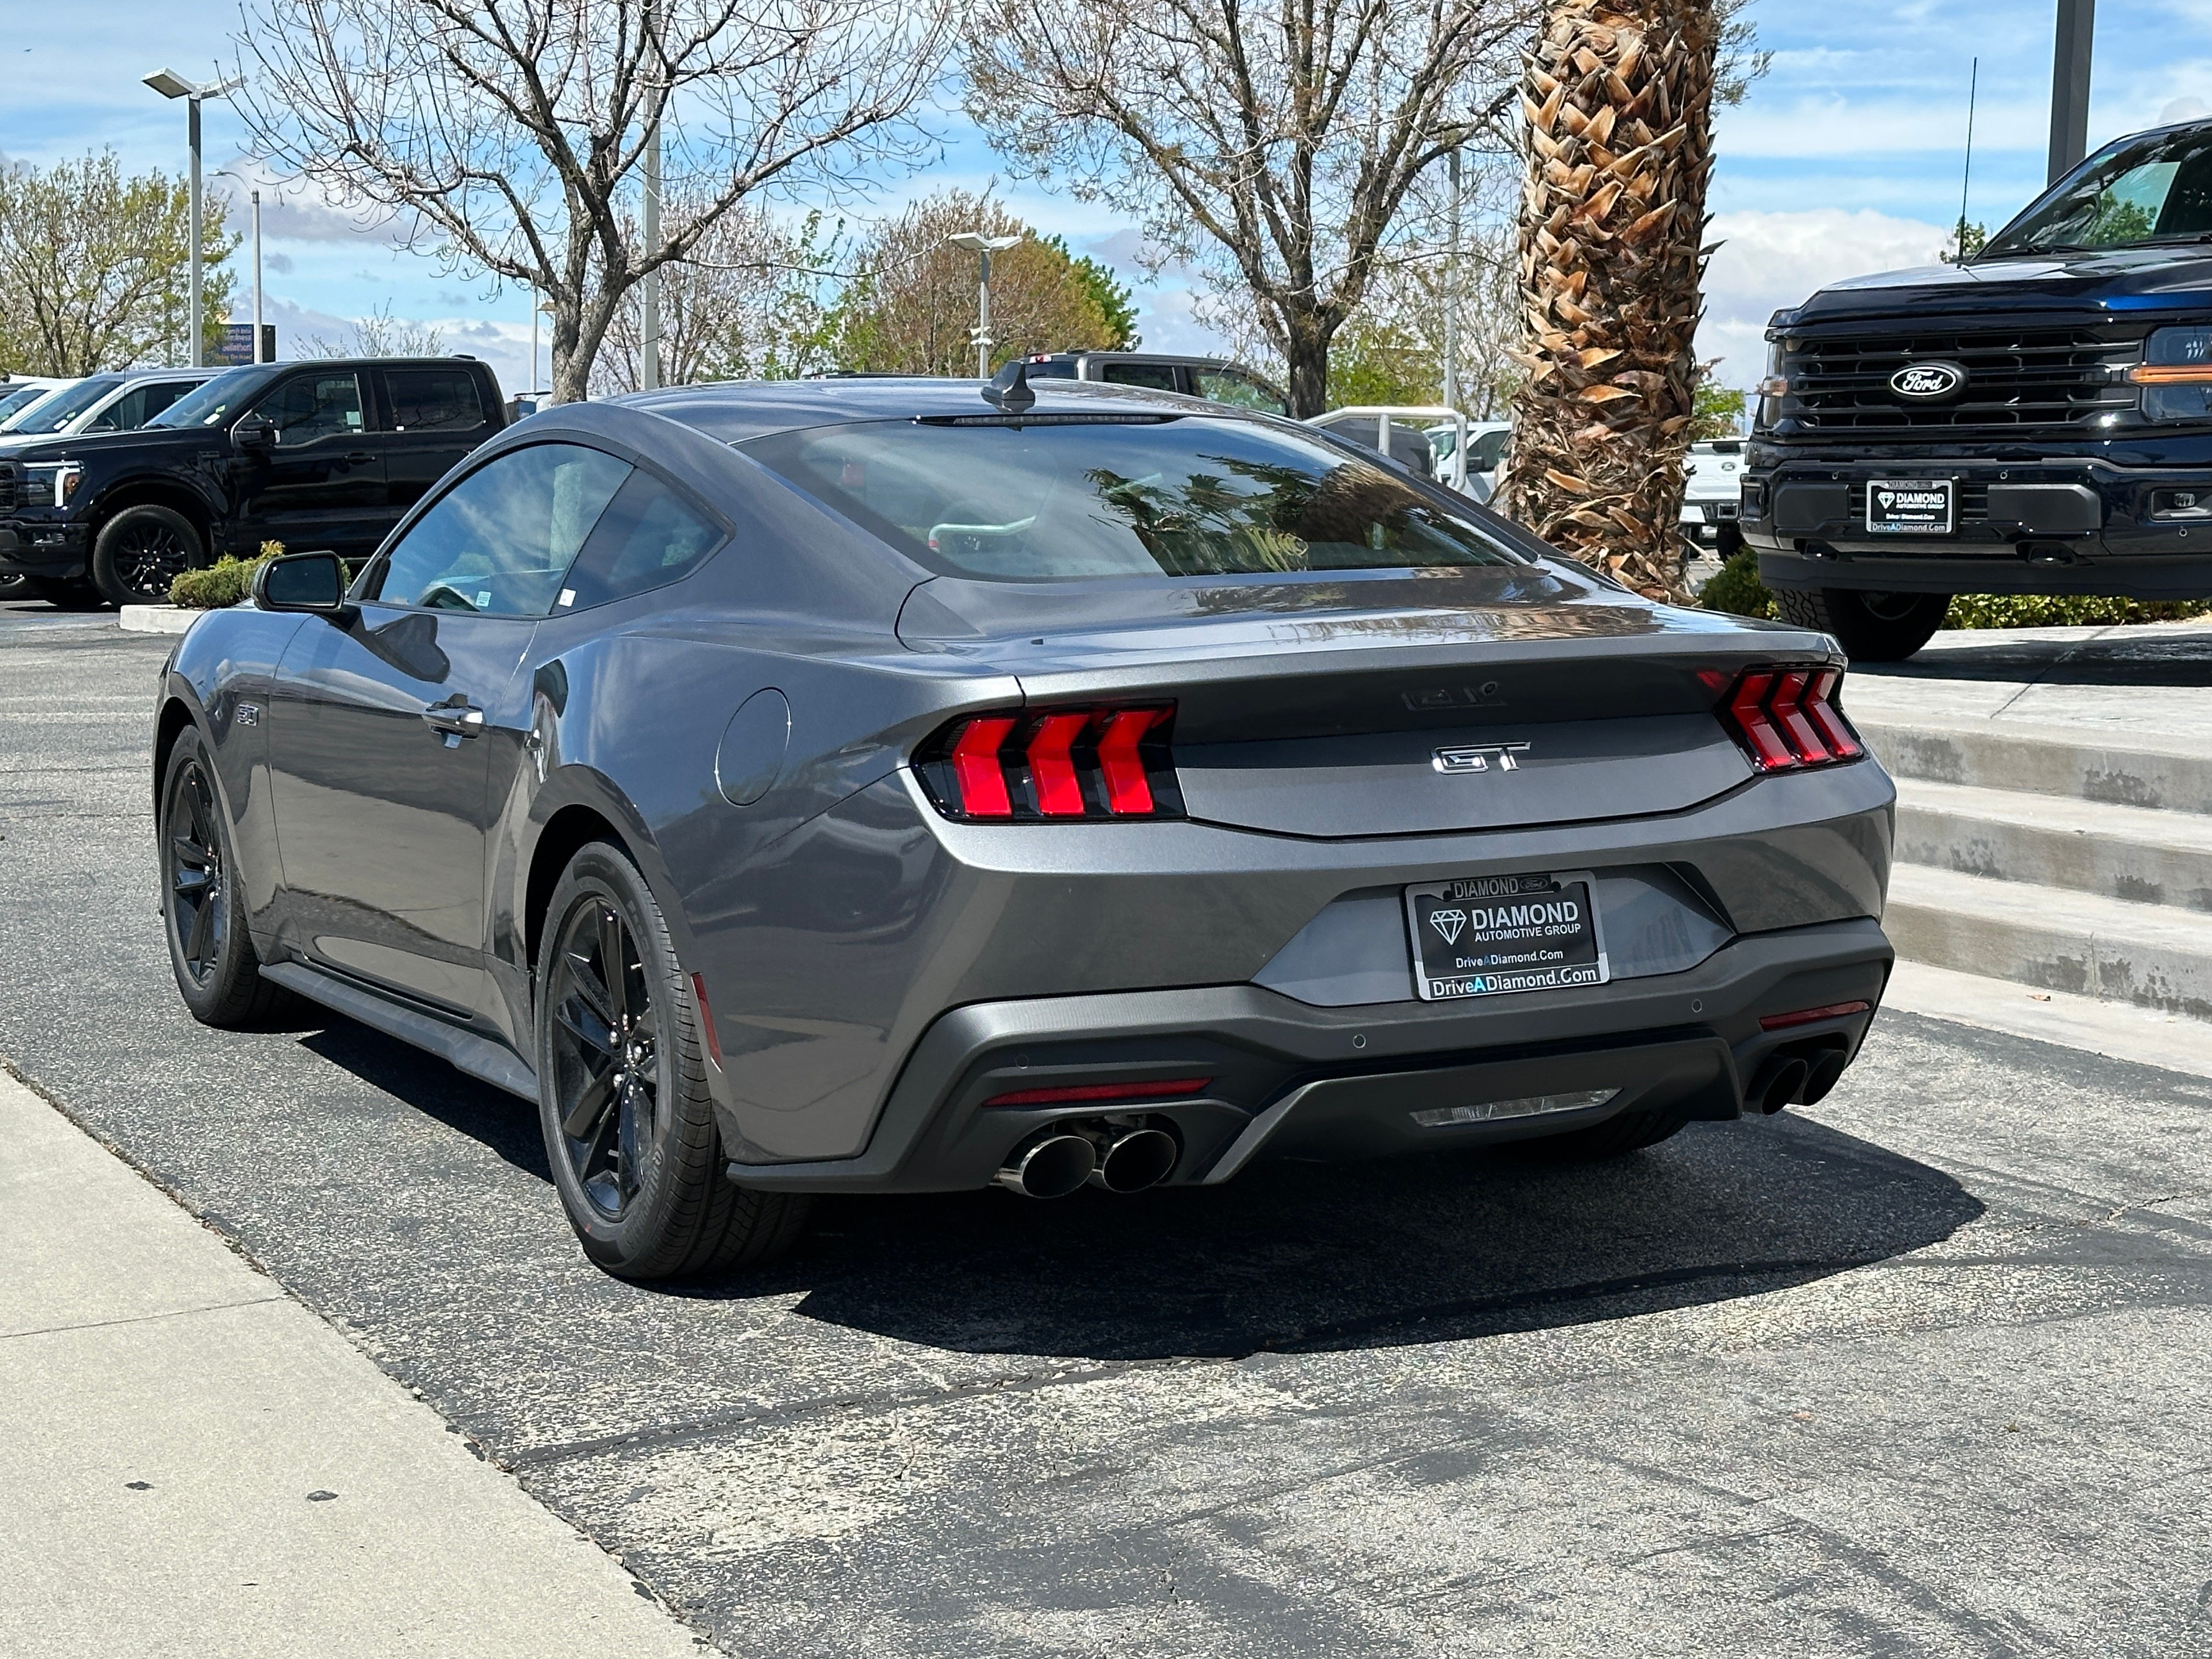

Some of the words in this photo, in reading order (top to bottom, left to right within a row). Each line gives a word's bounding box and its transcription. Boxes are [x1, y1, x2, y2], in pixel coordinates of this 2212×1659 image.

[1903, 370, 1944, 391] Ford
[1889, 480, 1918, 489] DIAMOND
[1896, 493, 1945, 504] DIAMOND
[1872, 522, 1945, 531] DriveADiamond.Com
[1430, 741, 1531, 775] GT
[1454, 878, 1519, 899] DIAMOND
[1472, 901, 1578, 930] DIAMOND
[1475, 927, 1542, 942] AUTOMOTIVE
[1545, 923, 1581, 935] GROUP
[1455, 950, 1564, 969] DriveADiamond.Com
[1433, 968, 1597, 997] DriveADiamond.Com
